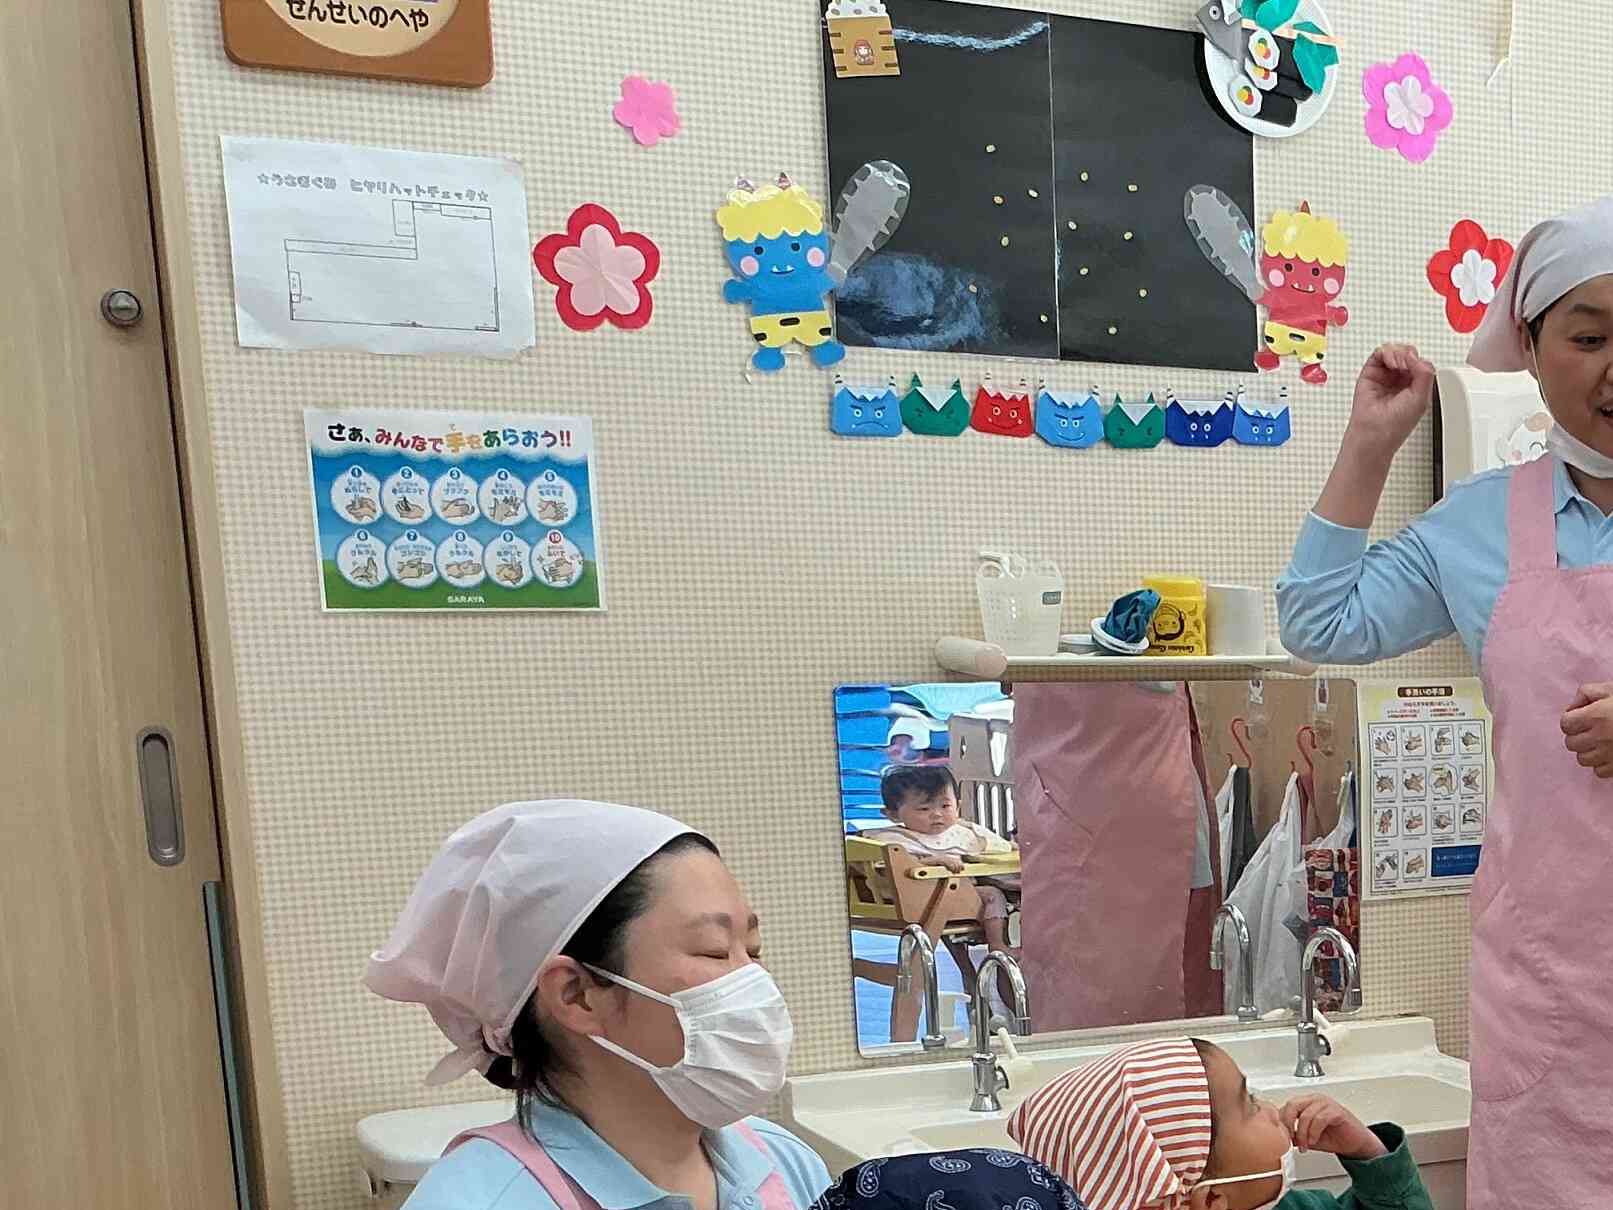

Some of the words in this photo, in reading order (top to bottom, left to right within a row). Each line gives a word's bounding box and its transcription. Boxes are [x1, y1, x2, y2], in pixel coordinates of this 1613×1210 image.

[286, 0, 429, 32] せんせいのへや
